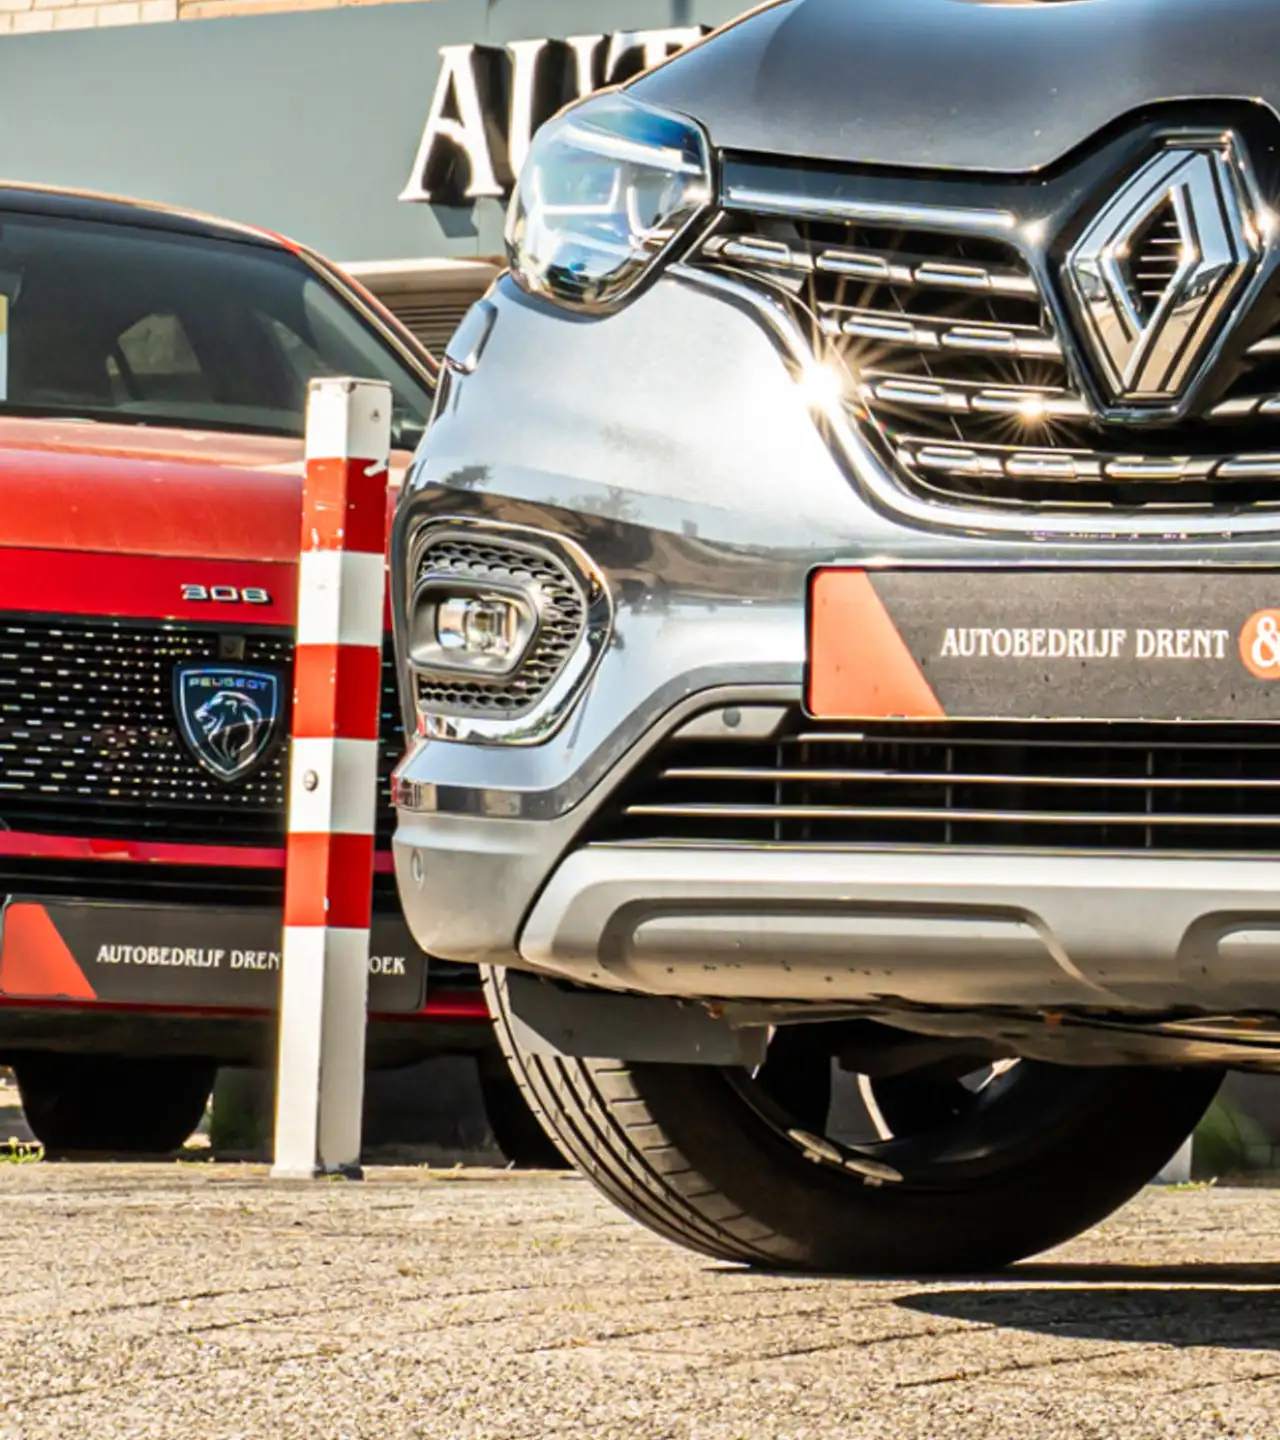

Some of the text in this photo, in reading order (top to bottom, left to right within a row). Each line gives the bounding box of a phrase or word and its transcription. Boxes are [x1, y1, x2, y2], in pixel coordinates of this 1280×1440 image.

[181, 584, 269, 603] 308
[940, 627, 1128, 659] AUTOBEDRIJF
[1135, 629, 1229, 659] DRENT
[96, 944, 225, 968] AUTOBEDRIJF
[230, 950, 281, 971] DREN
